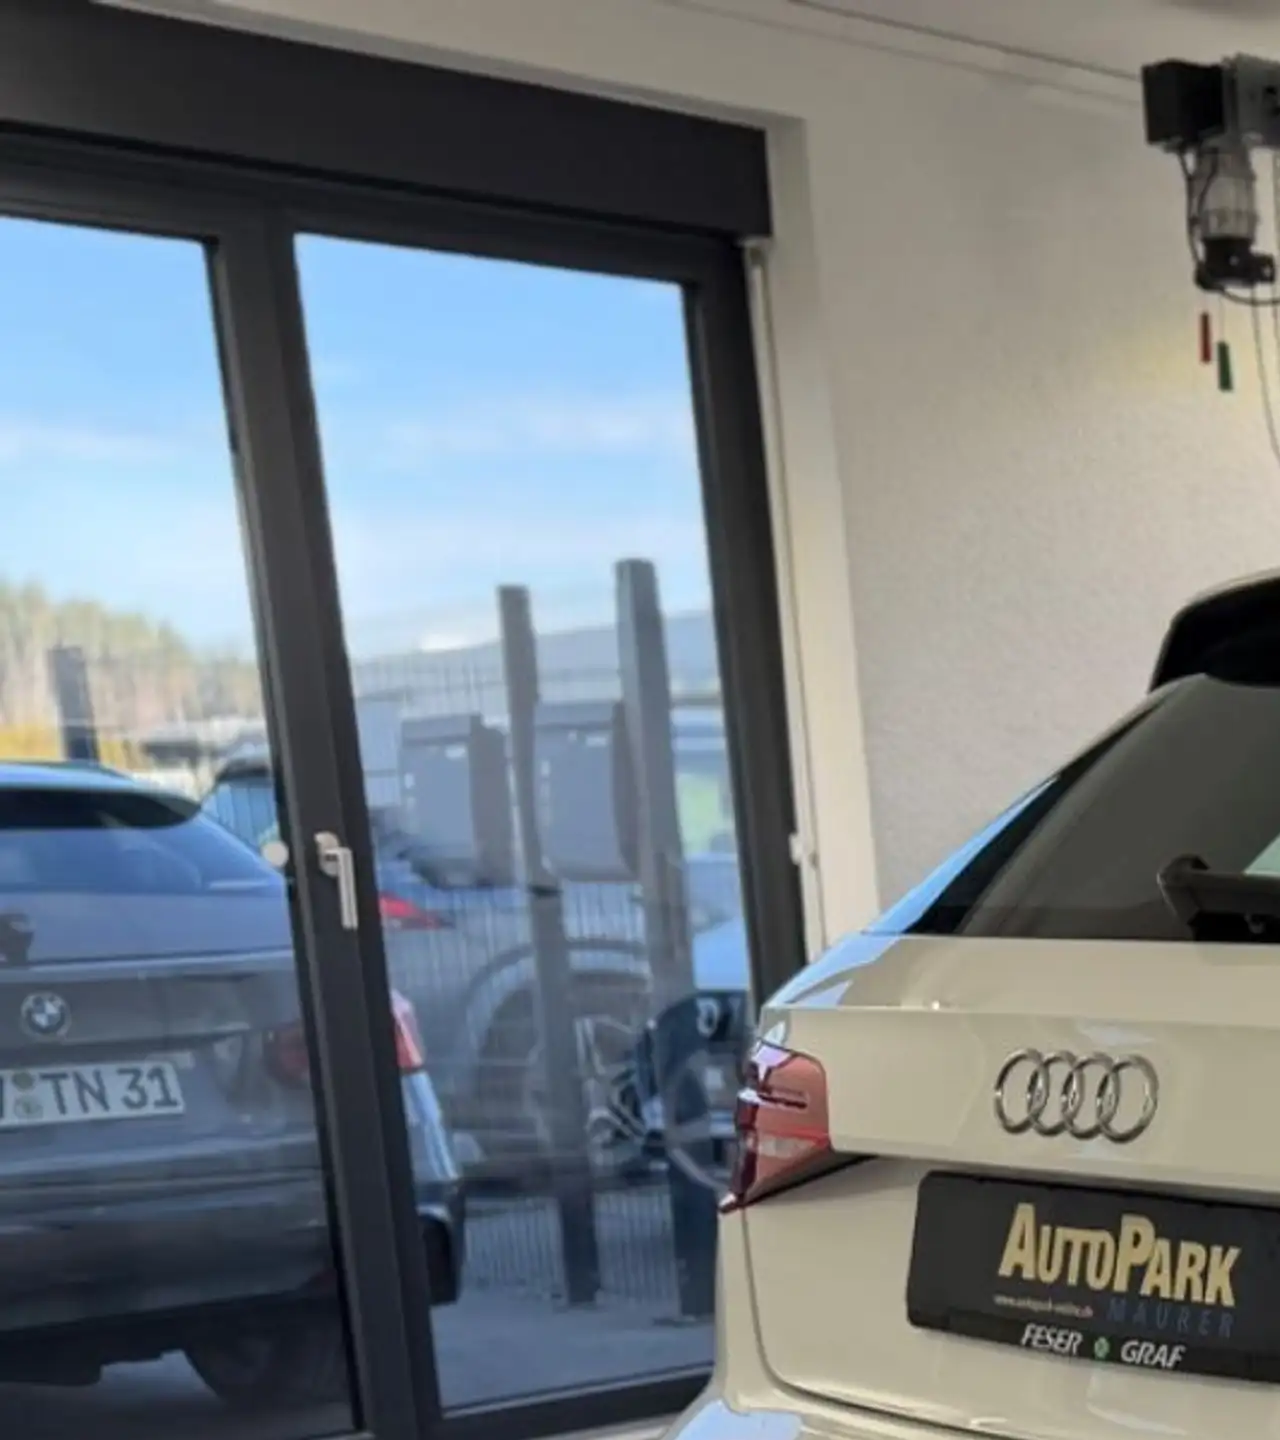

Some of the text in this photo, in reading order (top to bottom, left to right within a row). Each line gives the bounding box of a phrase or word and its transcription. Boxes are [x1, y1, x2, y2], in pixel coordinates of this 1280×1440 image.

[39, 1068, 110, 1115] TN
[117, 1067, 180, 1110] 31
[1105, 1298, 1235, 1339] MAURER
[1020, 1323, 1187, 1369] FESER GRAF
